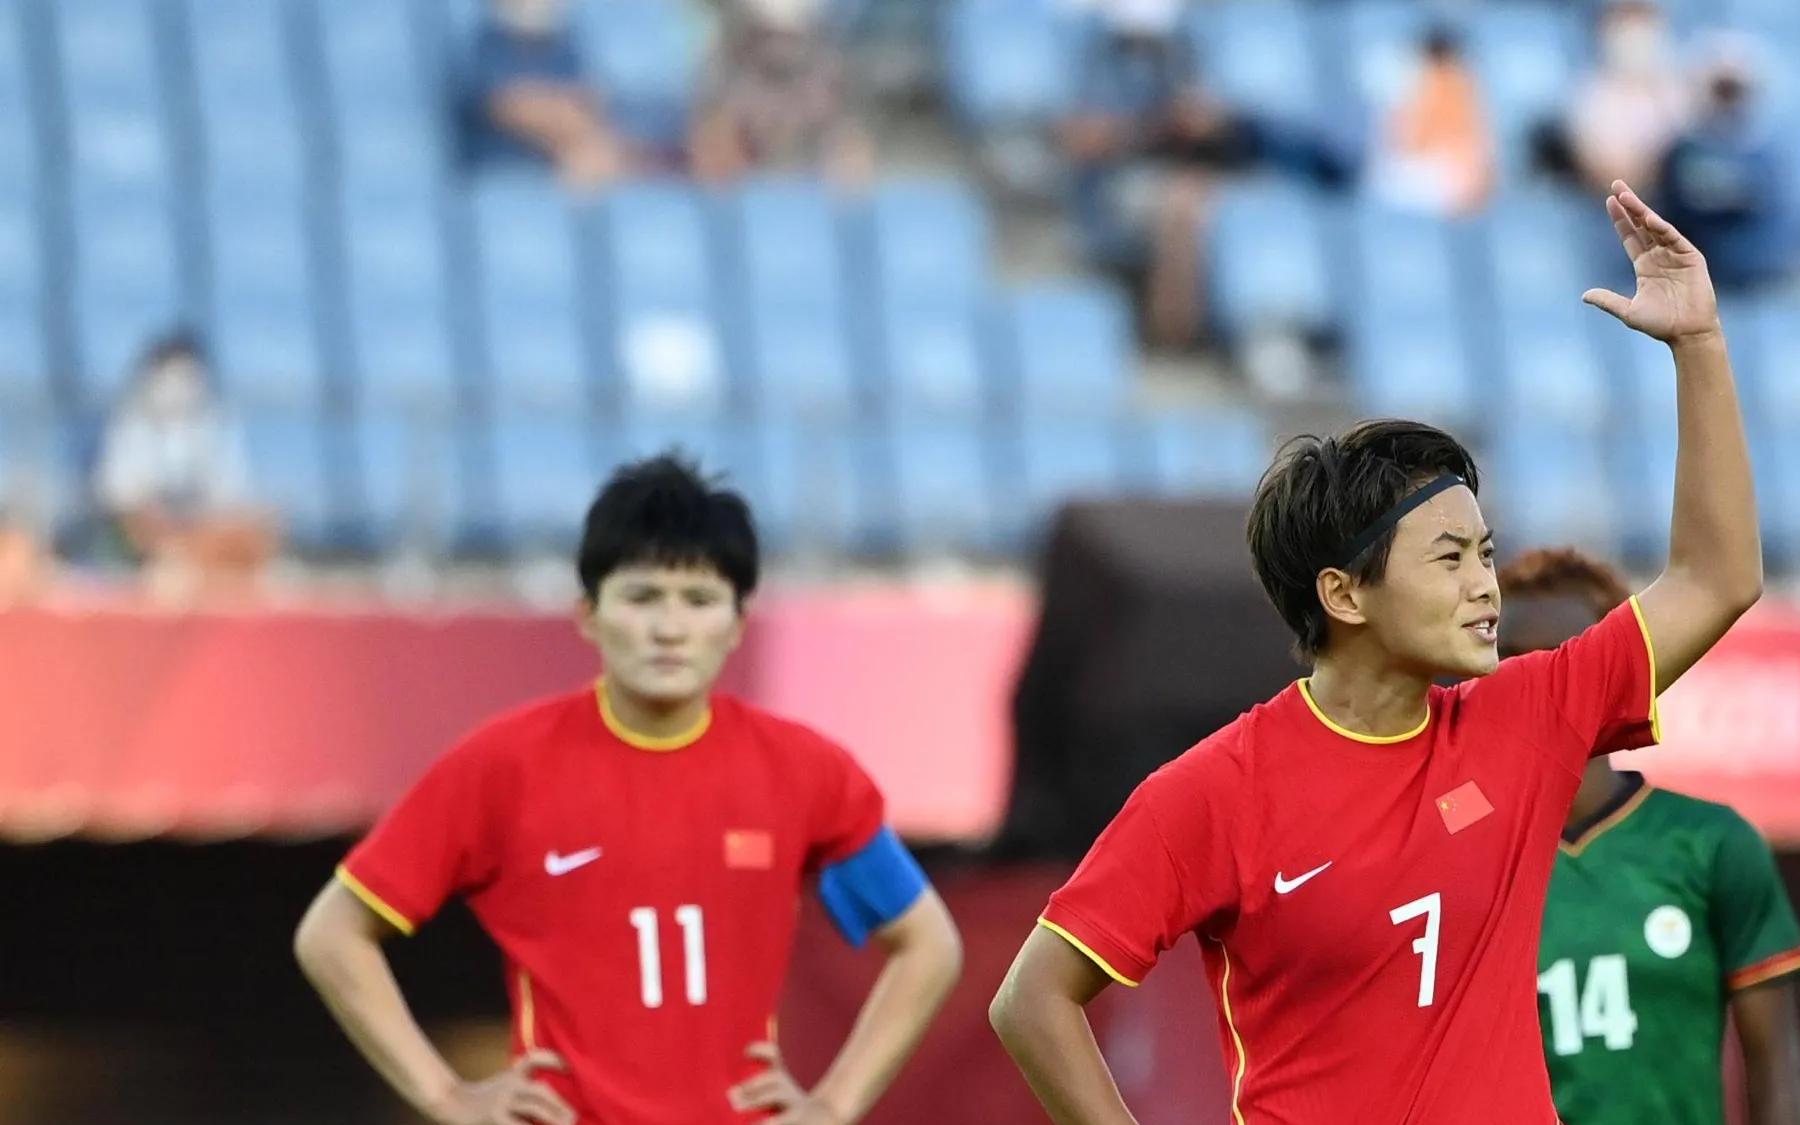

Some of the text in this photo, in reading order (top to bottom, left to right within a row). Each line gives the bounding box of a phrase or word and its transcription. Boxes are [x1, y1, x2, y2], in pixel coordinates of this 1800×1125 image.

[629, 904, 707, 1008] 11
[1389, 892, 1441, 1007] 7
[1536, 953, 1638, 1056] 14
